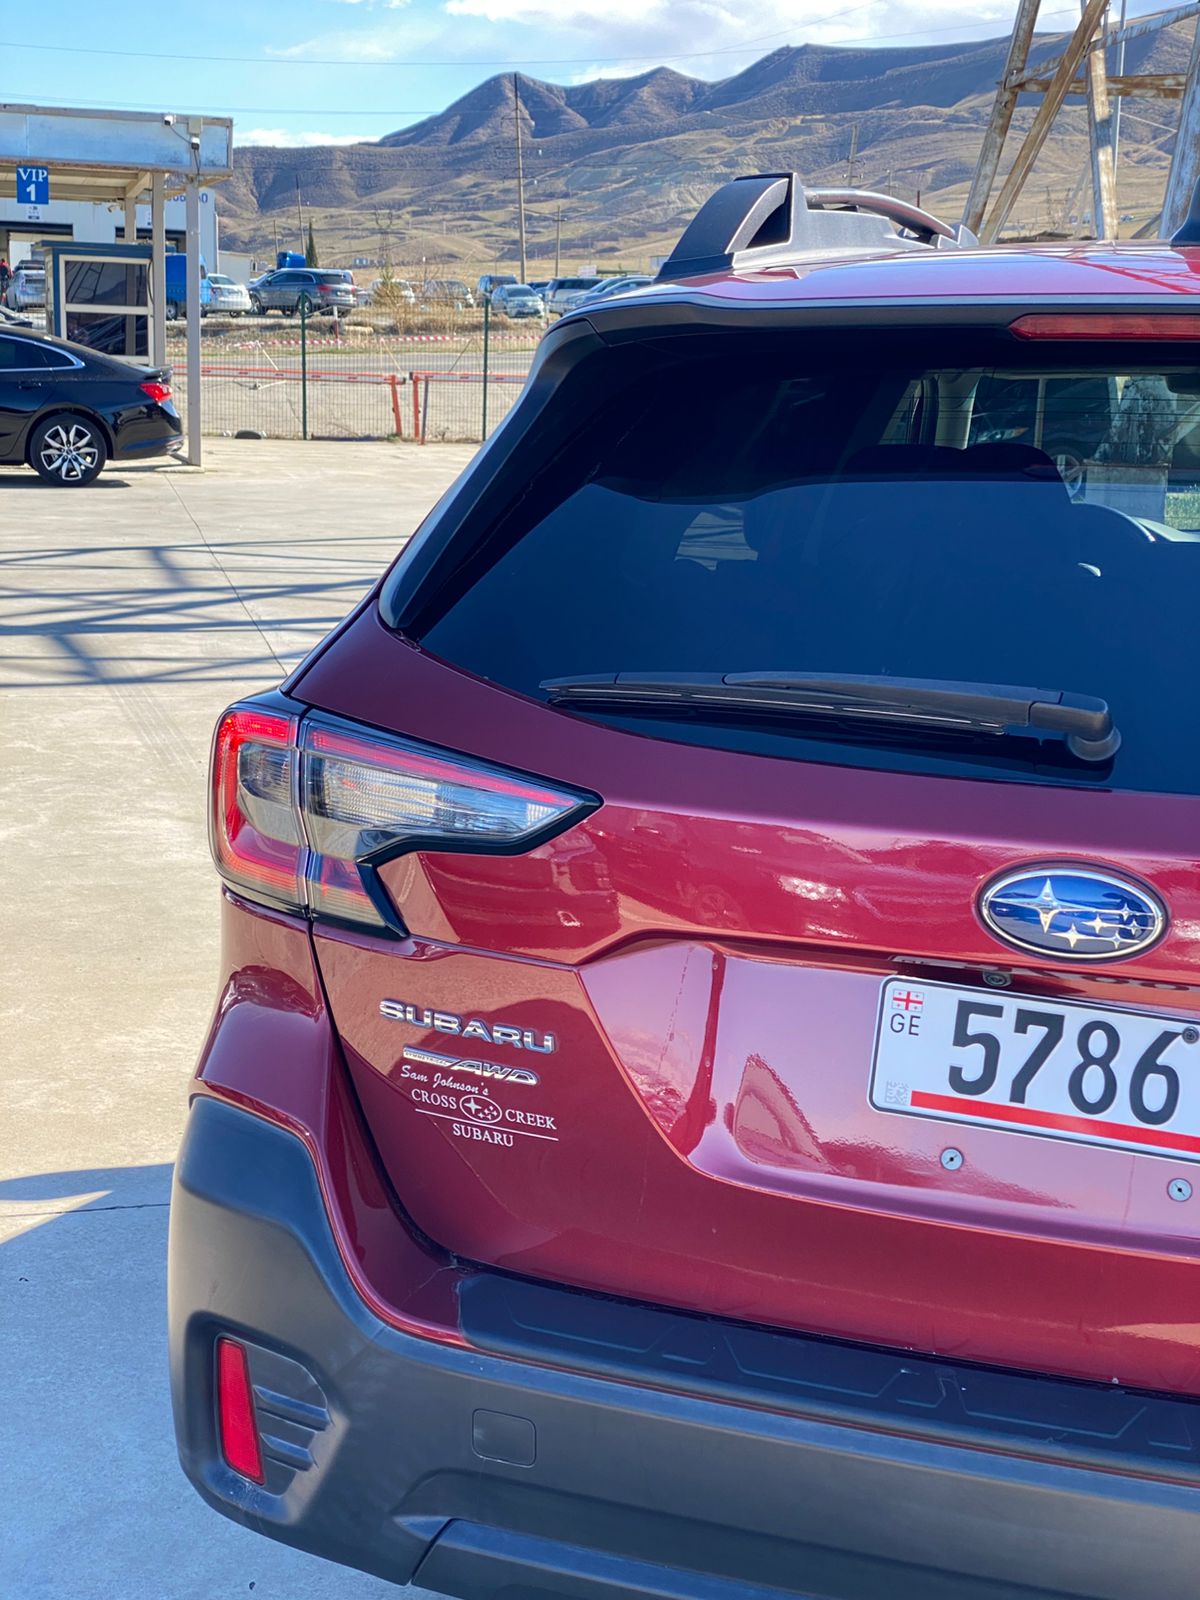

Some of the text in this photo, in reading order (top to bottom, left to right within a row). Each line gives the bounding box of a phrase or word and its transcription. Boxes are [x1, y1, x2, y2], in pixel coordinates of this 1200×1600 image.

[17, 167, 48, 182] VIP
[26, 183, 36, 202] 1
[379, 998, 557, 1054] SUBARU
[890, 1013, 921, 1036] GE
[450, 1059, 538, 1085] AWD
[948, 999, 1183, 1126] 5786
[400, 1064, 490, 1097] Sam Johnson's
[411, 1088, 558, 1130] CROSS CREEK
[452, 1123, 514, 1148] SUBARU
